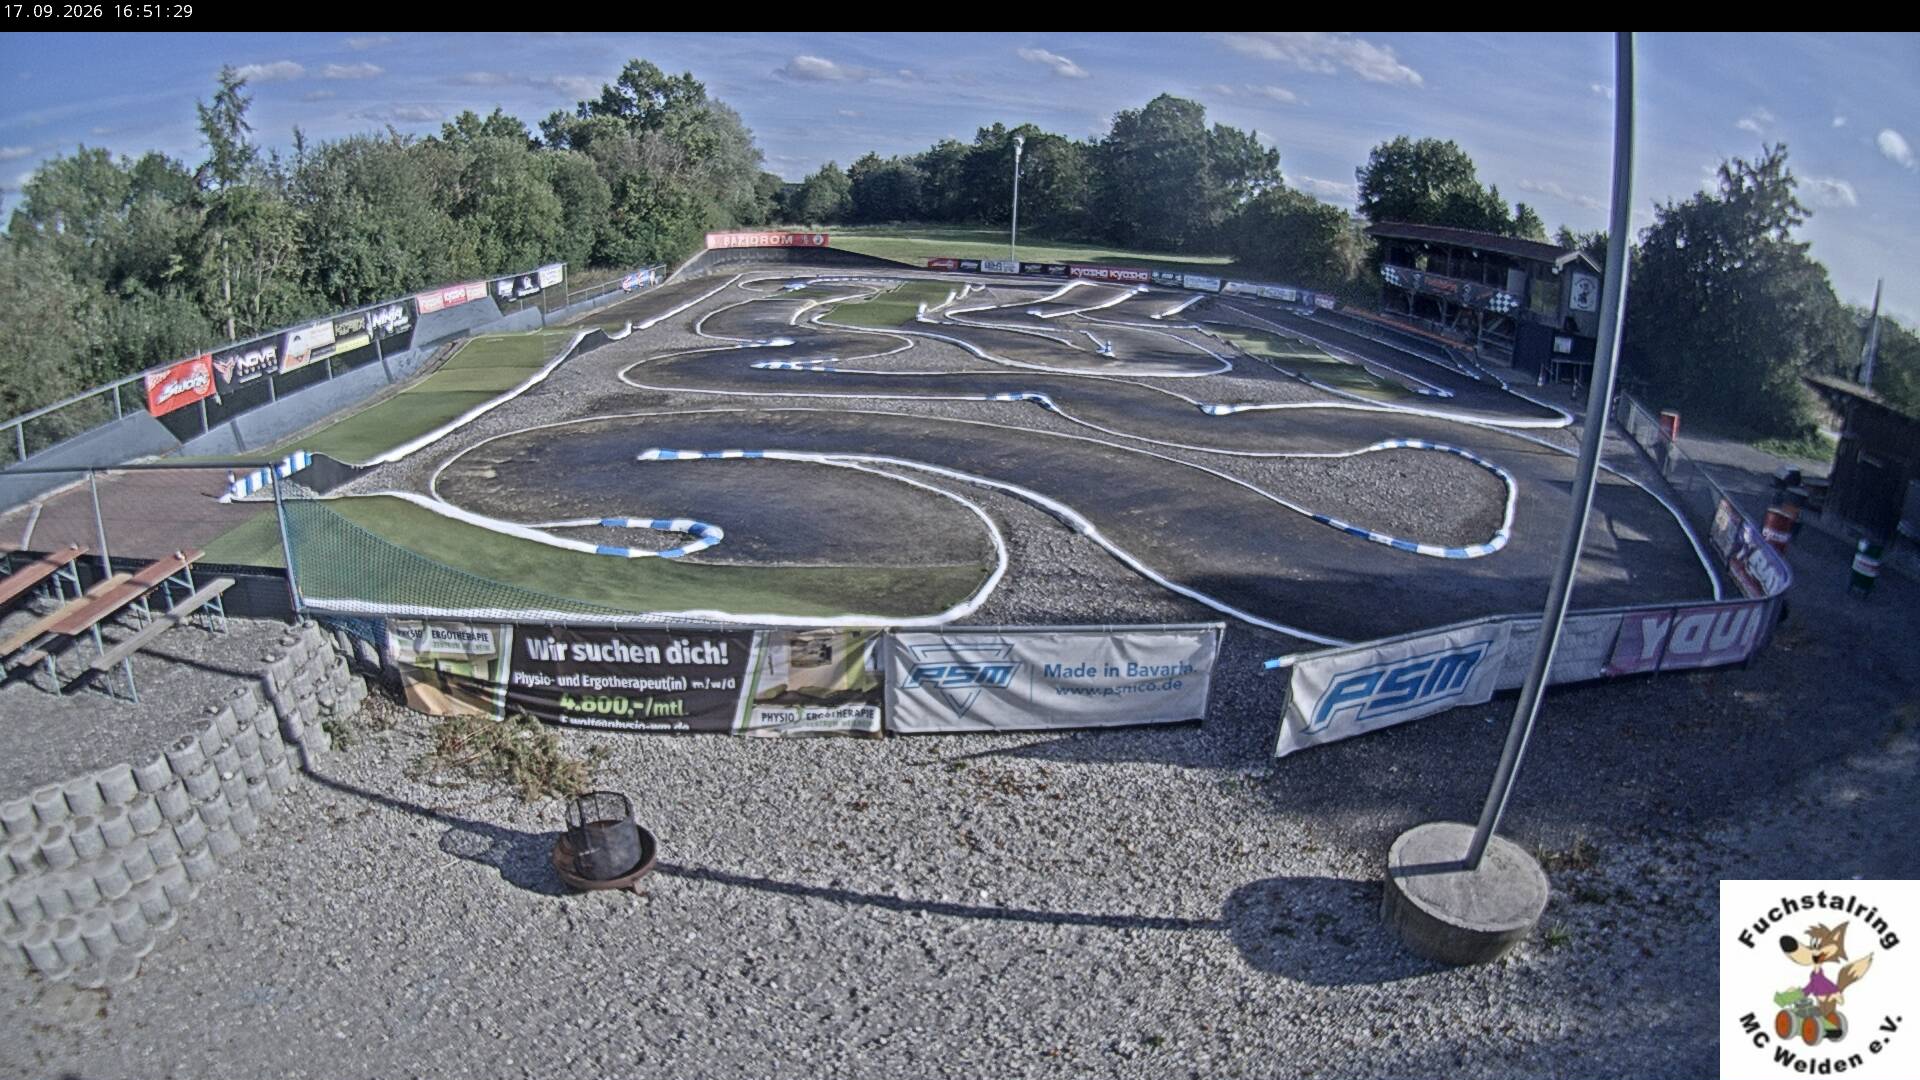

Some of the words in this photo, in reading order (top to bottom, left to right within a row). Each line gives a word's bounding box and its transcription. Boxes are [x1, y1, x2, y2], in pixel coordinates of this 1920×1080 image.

[1070, 266, 1108, 277] KYOSHO
[1109, 268, 1148, 280] KYOSHO
[237, 346, 278, 371] NOVA
[432, 629, 489, 642] ERGOTHERAPIE
[526, 637, 567, 661] Wir
[571, 639, 660, 664] suchen
[665, 639, 729, 665] dich!
[513, 671, 555, 688] Physio-
[558, 673, 580, 687] und
[582, 674, 687, 692] Ergotherapeut(in)
[692, 678, 736, 690] m/w/d
[911, 664, 1014, 687] PSM
[1044, 663, 1097, 679] Made
[1103, 663, 1120, 678] in
[1313, 647, 1483, 725] PSM
[761, 712, 795, 722] PHYSIO
